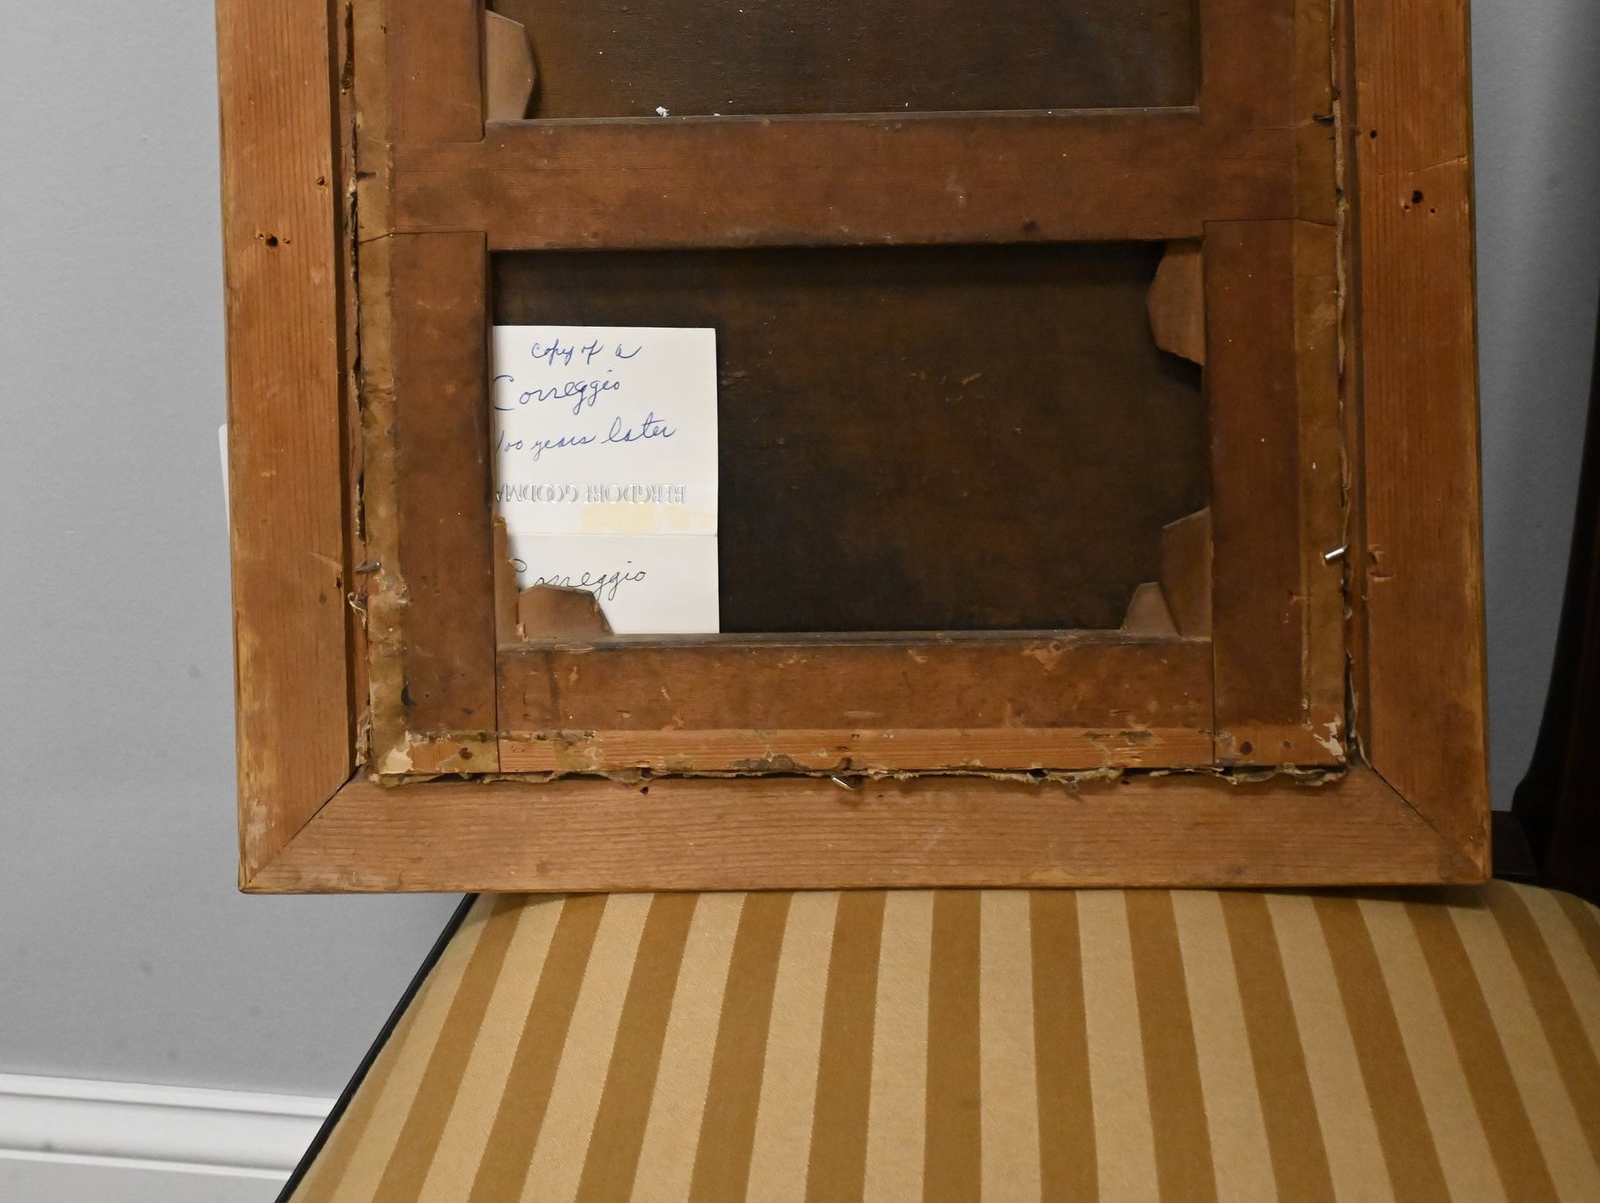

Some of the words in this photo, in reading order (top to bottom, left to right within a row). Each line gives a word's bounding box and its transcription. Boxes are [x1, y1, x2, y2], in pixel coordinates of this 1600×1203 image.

[581, 339, 605, 365] of
[615, 343, 643, 359] a
[531, 435, 598, 462] years
[600, 411, 677, 444] later
[585, 483, 686, 505] BERGDORF
